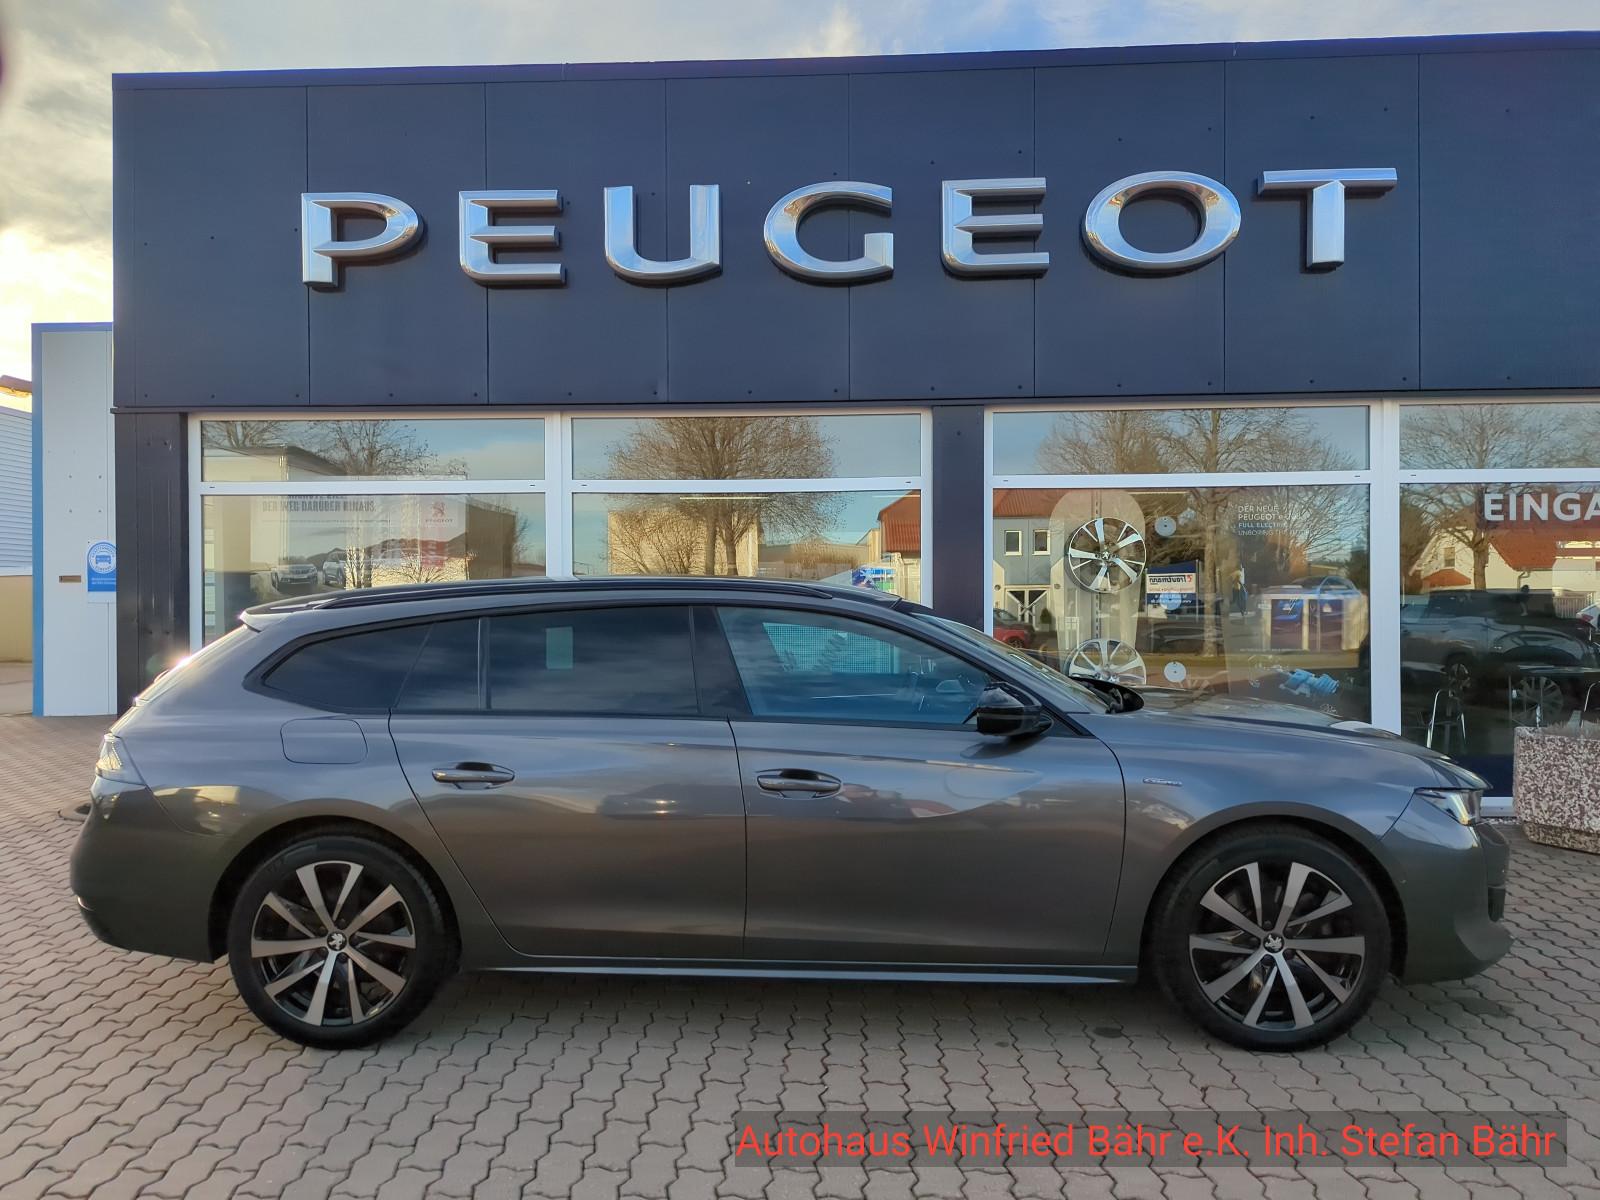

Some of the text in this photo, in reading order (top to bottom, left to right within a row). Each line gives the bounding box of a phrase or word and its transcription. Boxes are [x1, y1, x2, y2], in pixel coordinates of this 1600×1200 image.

[300, 167, 1398, 287] PEUGEOT
[1238, 505, 1279, 513] DER NEUE
